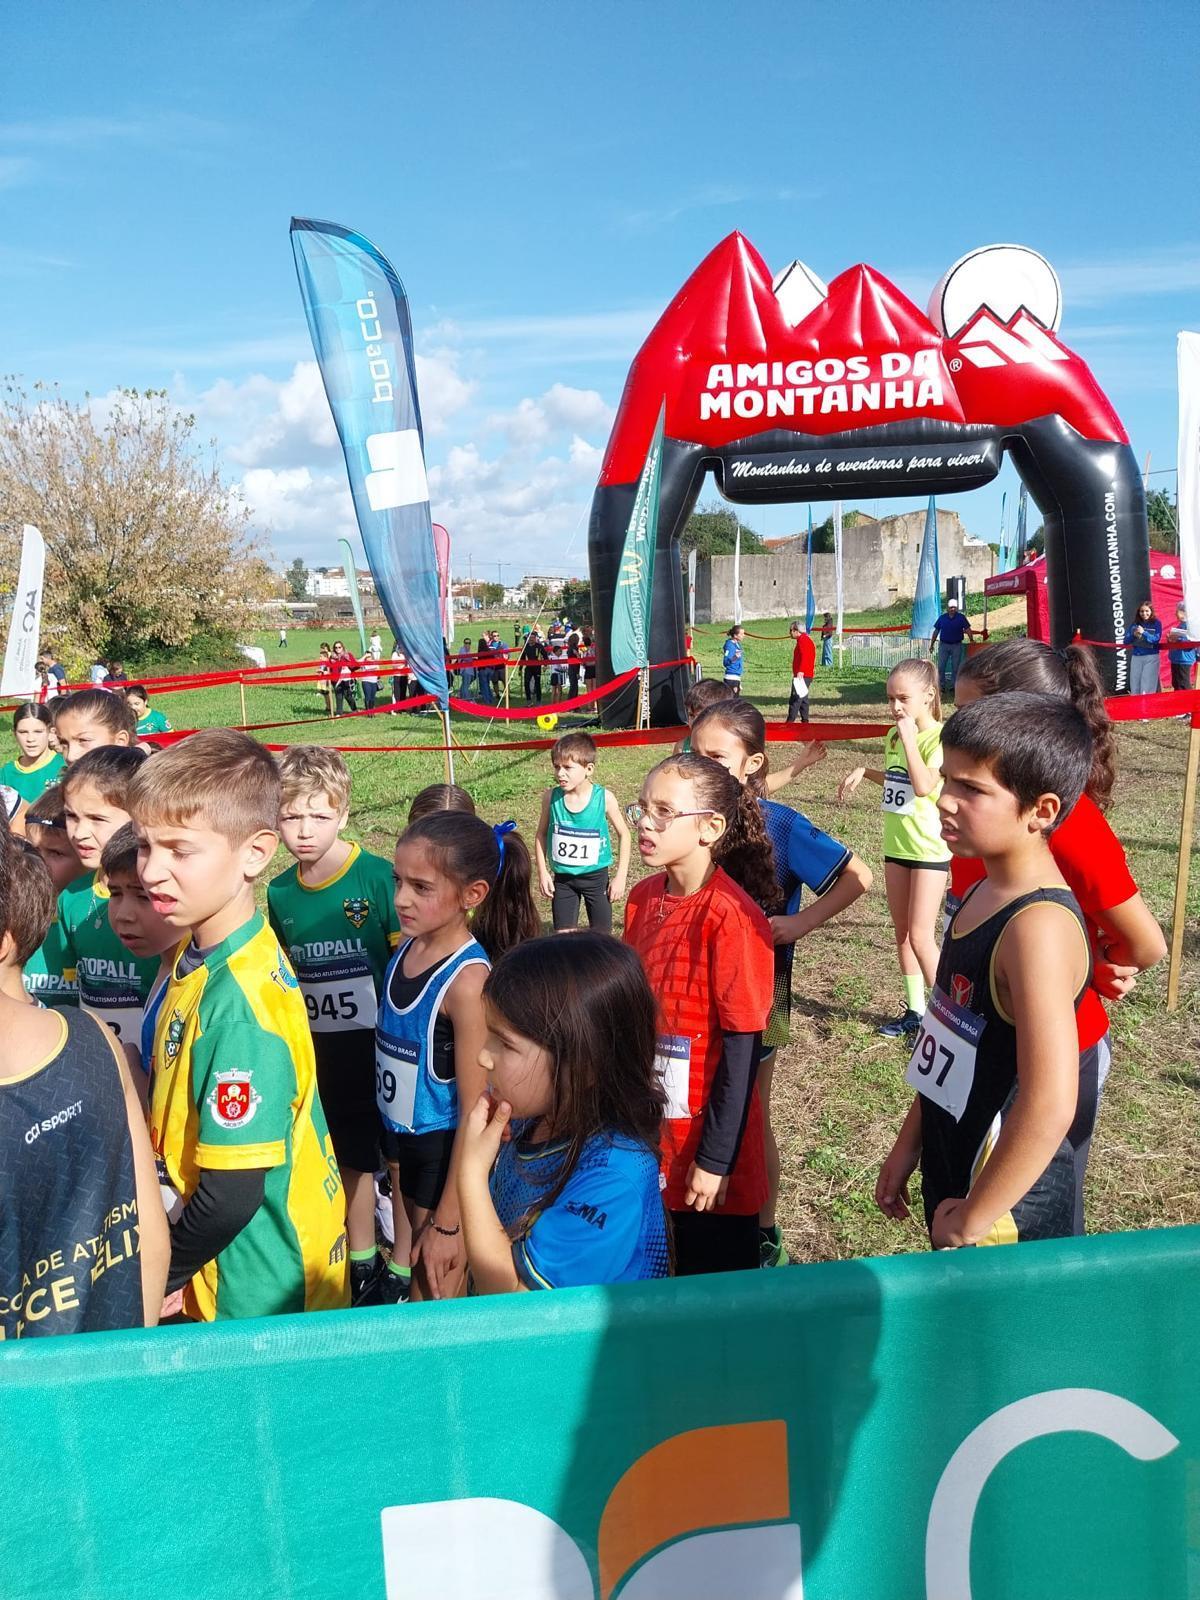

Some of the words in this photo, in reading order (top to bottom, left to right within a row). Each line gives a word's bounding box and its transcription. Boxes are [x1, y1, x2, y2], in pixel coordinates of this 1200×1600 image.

[706, 355, 872, 390] AMIGOS
[880, 348, 940, 380] DA
[700, 377, 945, 421] MONTANHA
[731, 458, 811, 478] Montanhas
[815, 457, 832, 473] de
[836, 456, 904, 473] aventuras
[906, 455, 943, 473] para
[946, 443, 992, 467] viver!
[557, 841, 588, 859] 821
[304, 938, 367, 958] TOPALL
[81, 957, 141, 980] TOPALL
[350, 965, 368, 973] BRAGA
[305, 991, 358, 1020] 945
[397, 1046, 417, 1058] BRAGA
[35, 1249, 65, 1279] DE
